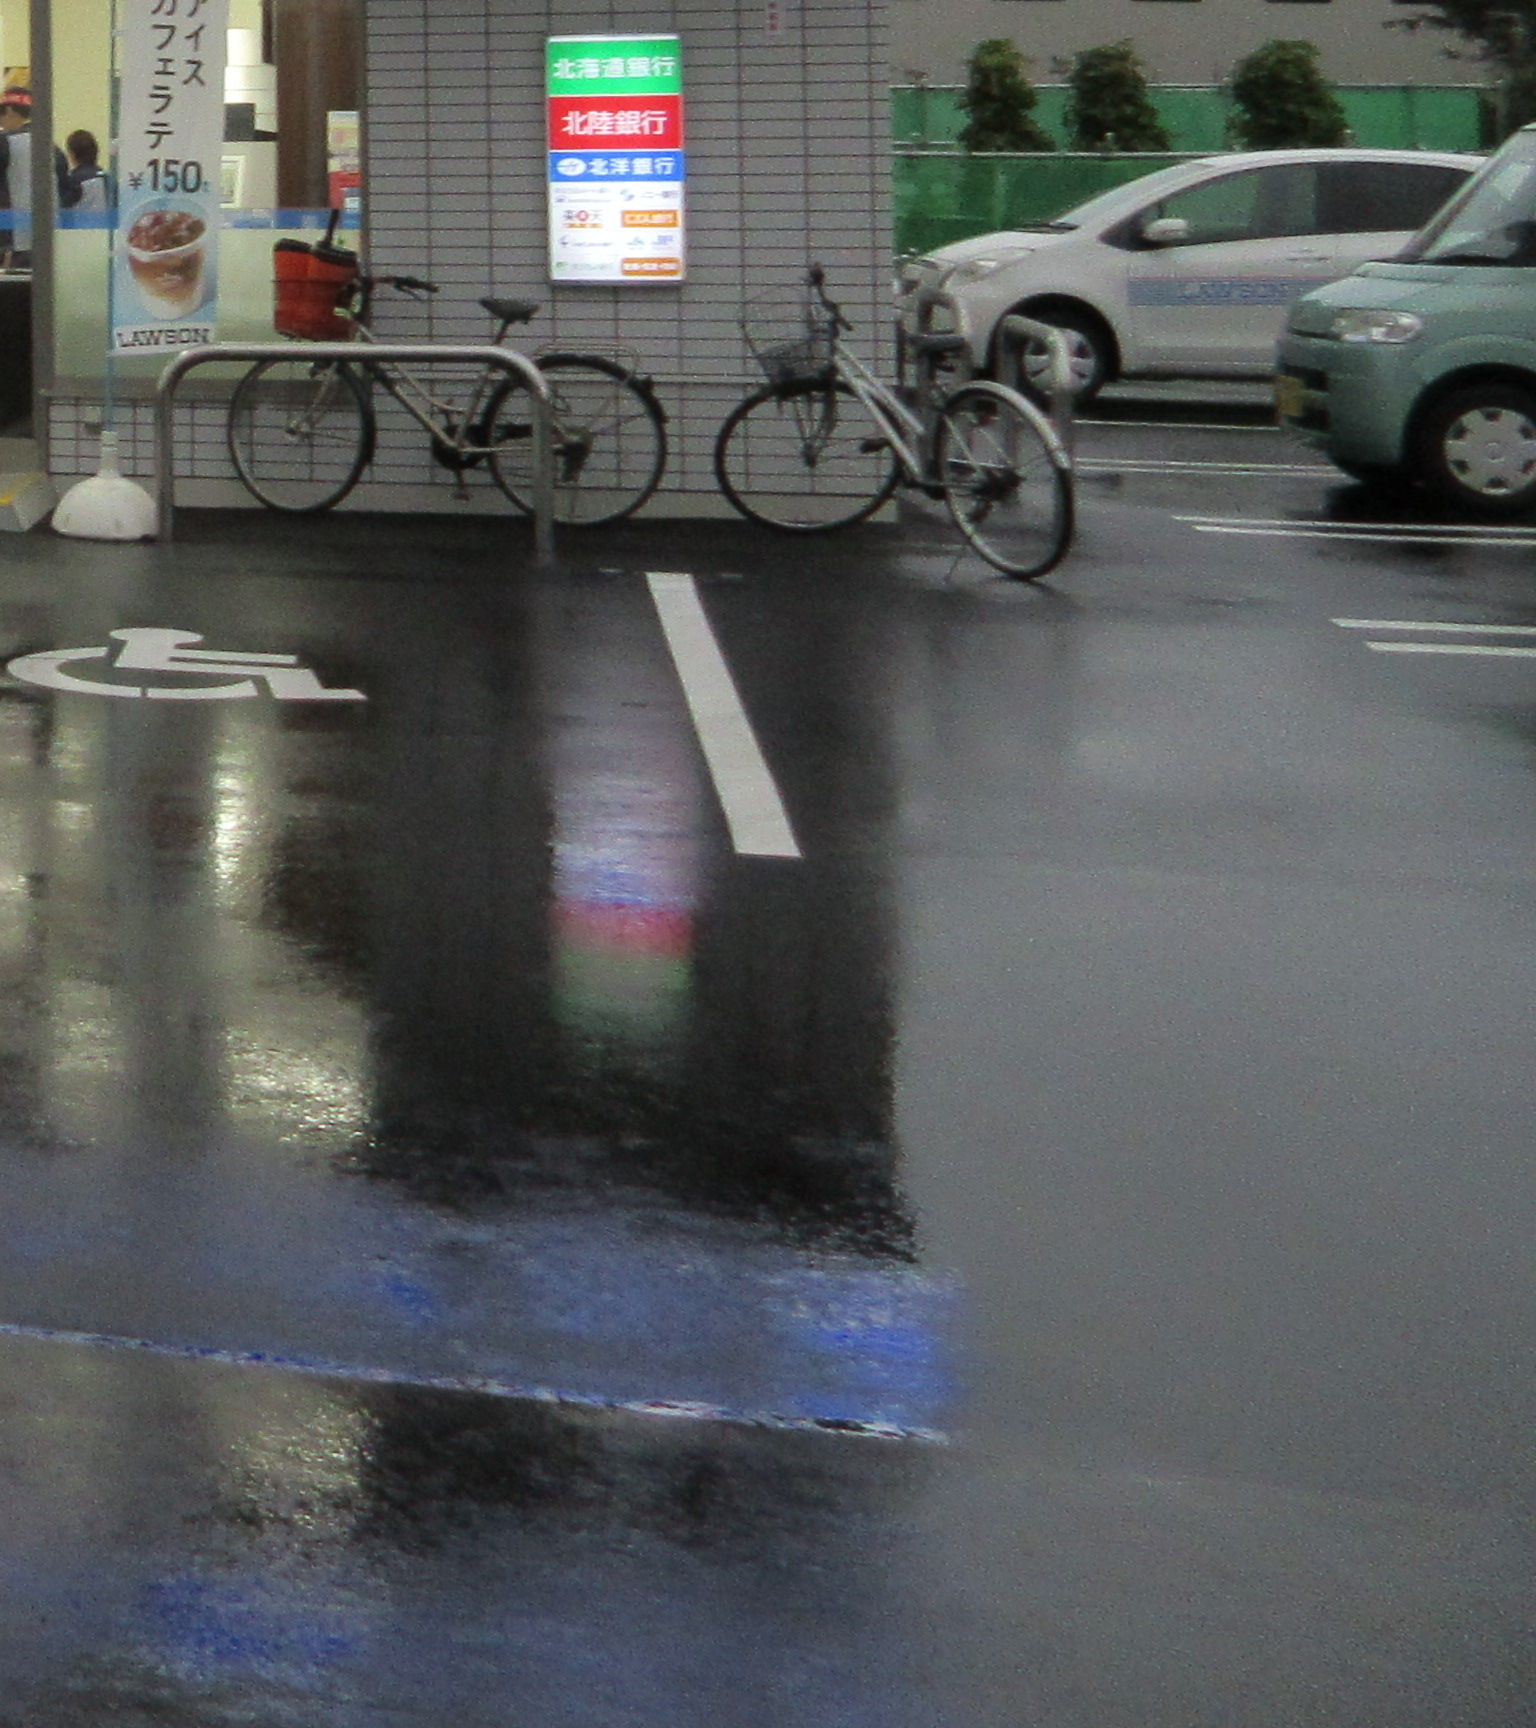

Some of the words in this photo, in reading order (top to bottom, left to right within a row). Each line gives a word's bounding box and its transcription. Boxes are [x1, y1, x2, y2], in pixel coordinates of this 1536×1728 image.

[553, 56, 676, 79] 北海道銀行
[561, 110, 668, 135] 北陸銀行
[589, 157, 675, 175] 北洋銀行
